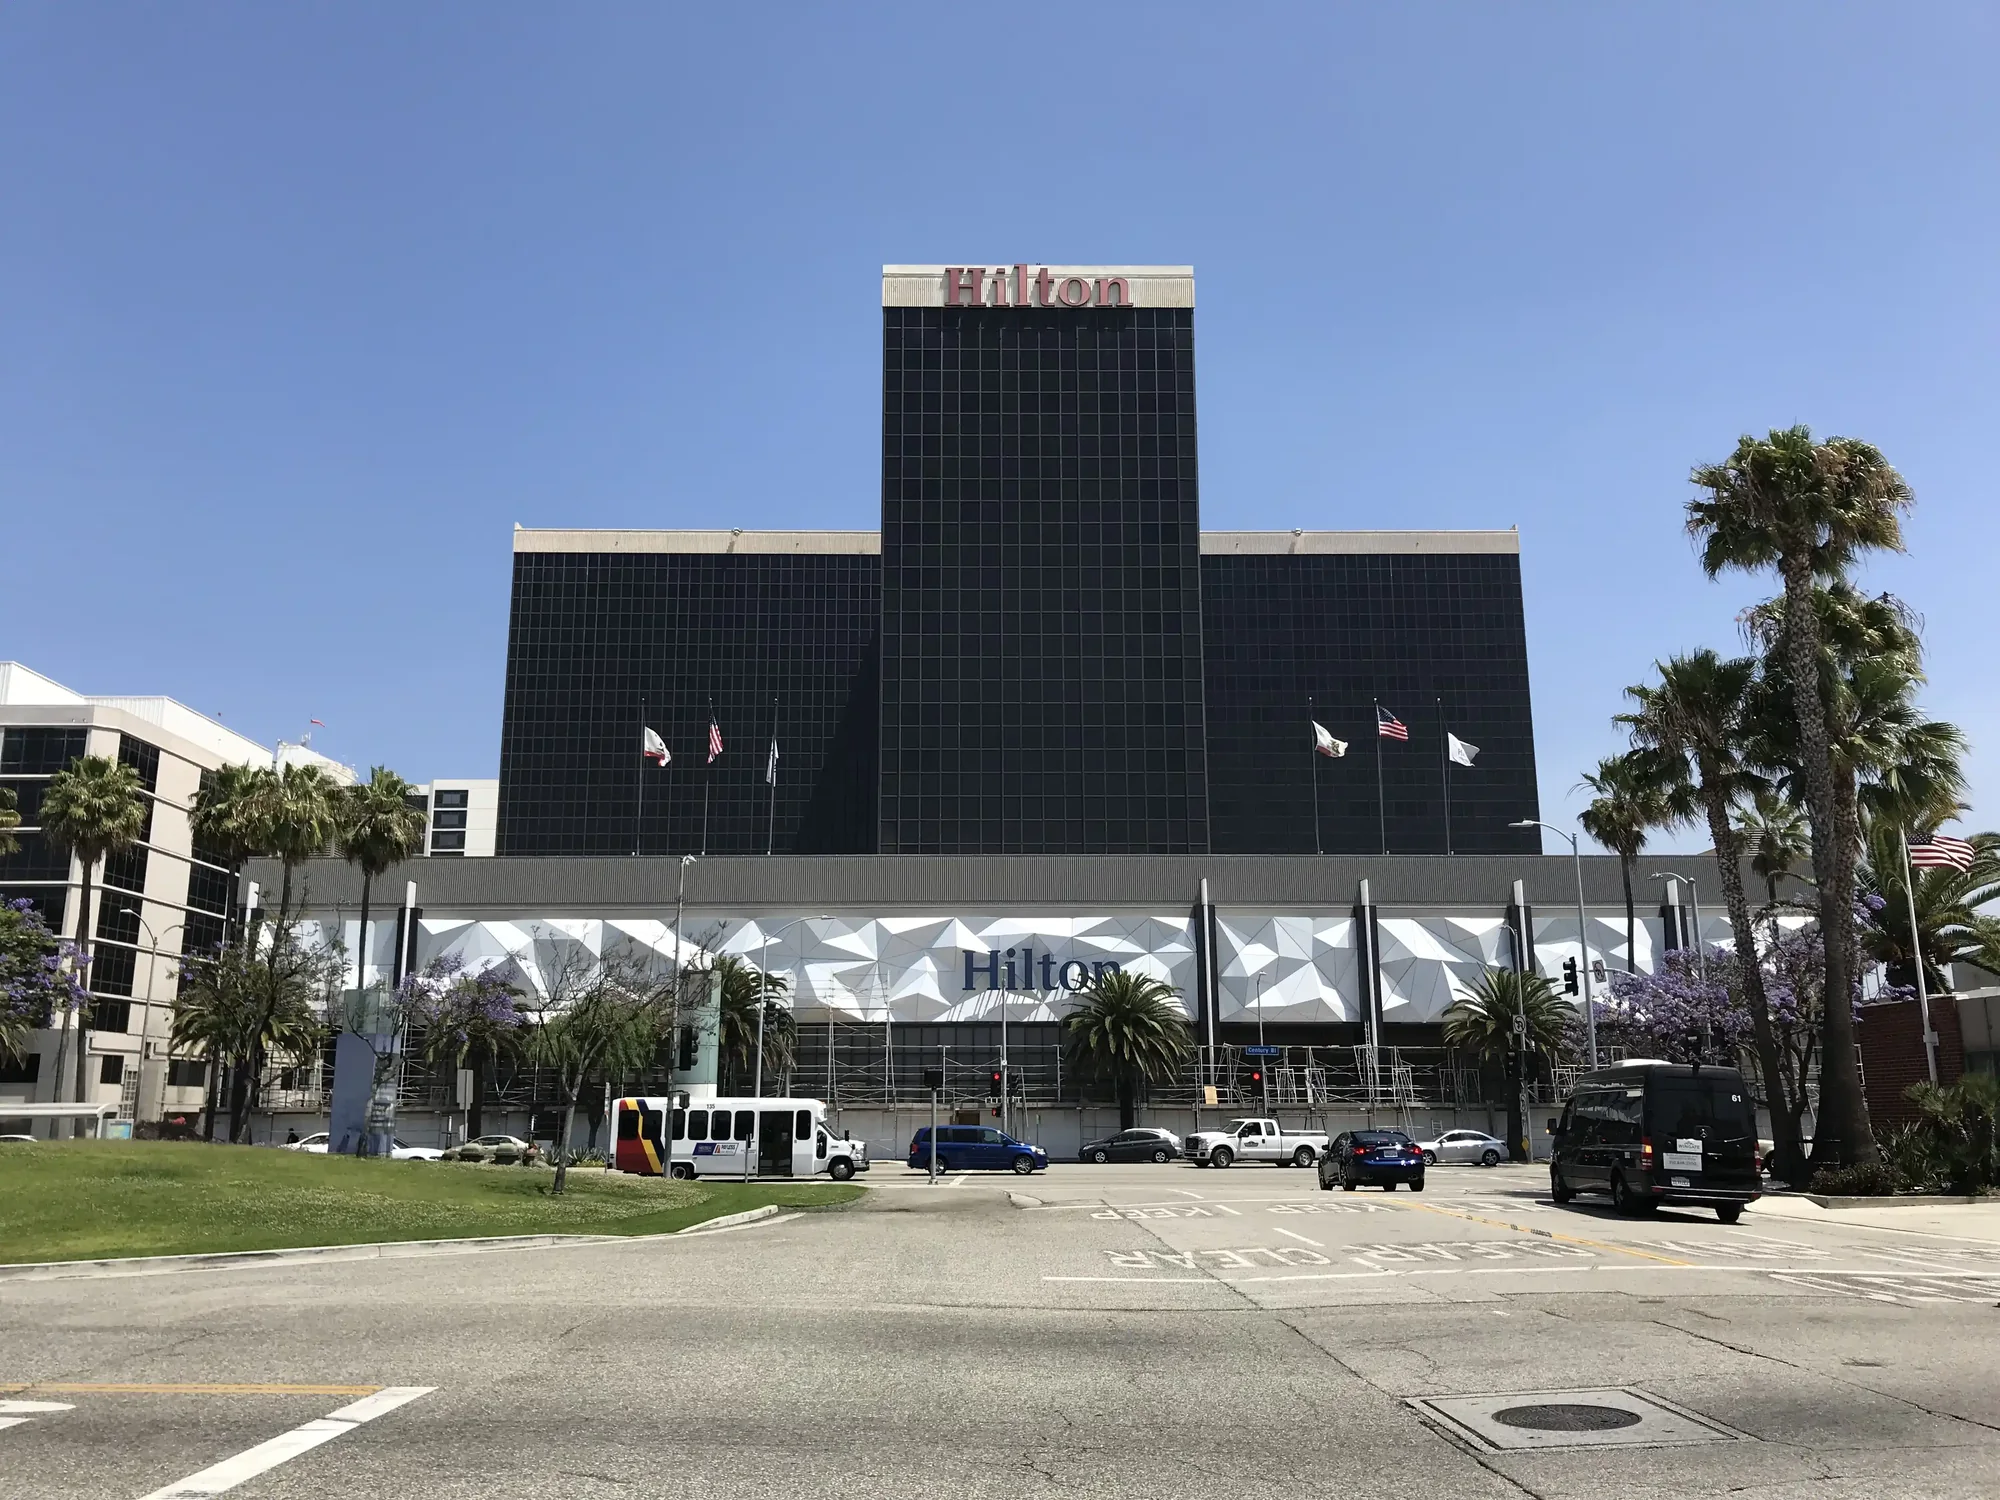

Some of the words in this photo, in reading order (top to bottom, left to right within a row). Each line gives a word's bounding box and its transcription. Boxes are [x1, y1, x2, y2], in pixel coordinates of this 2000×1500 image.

[945, 264, 1134, 307] Hilton
[1731, 1094, 1741, 1102] 61
[1090, 1206, 1213, 1220] KEEP
[1103, 1248, 1333, 1268] CLEAR
